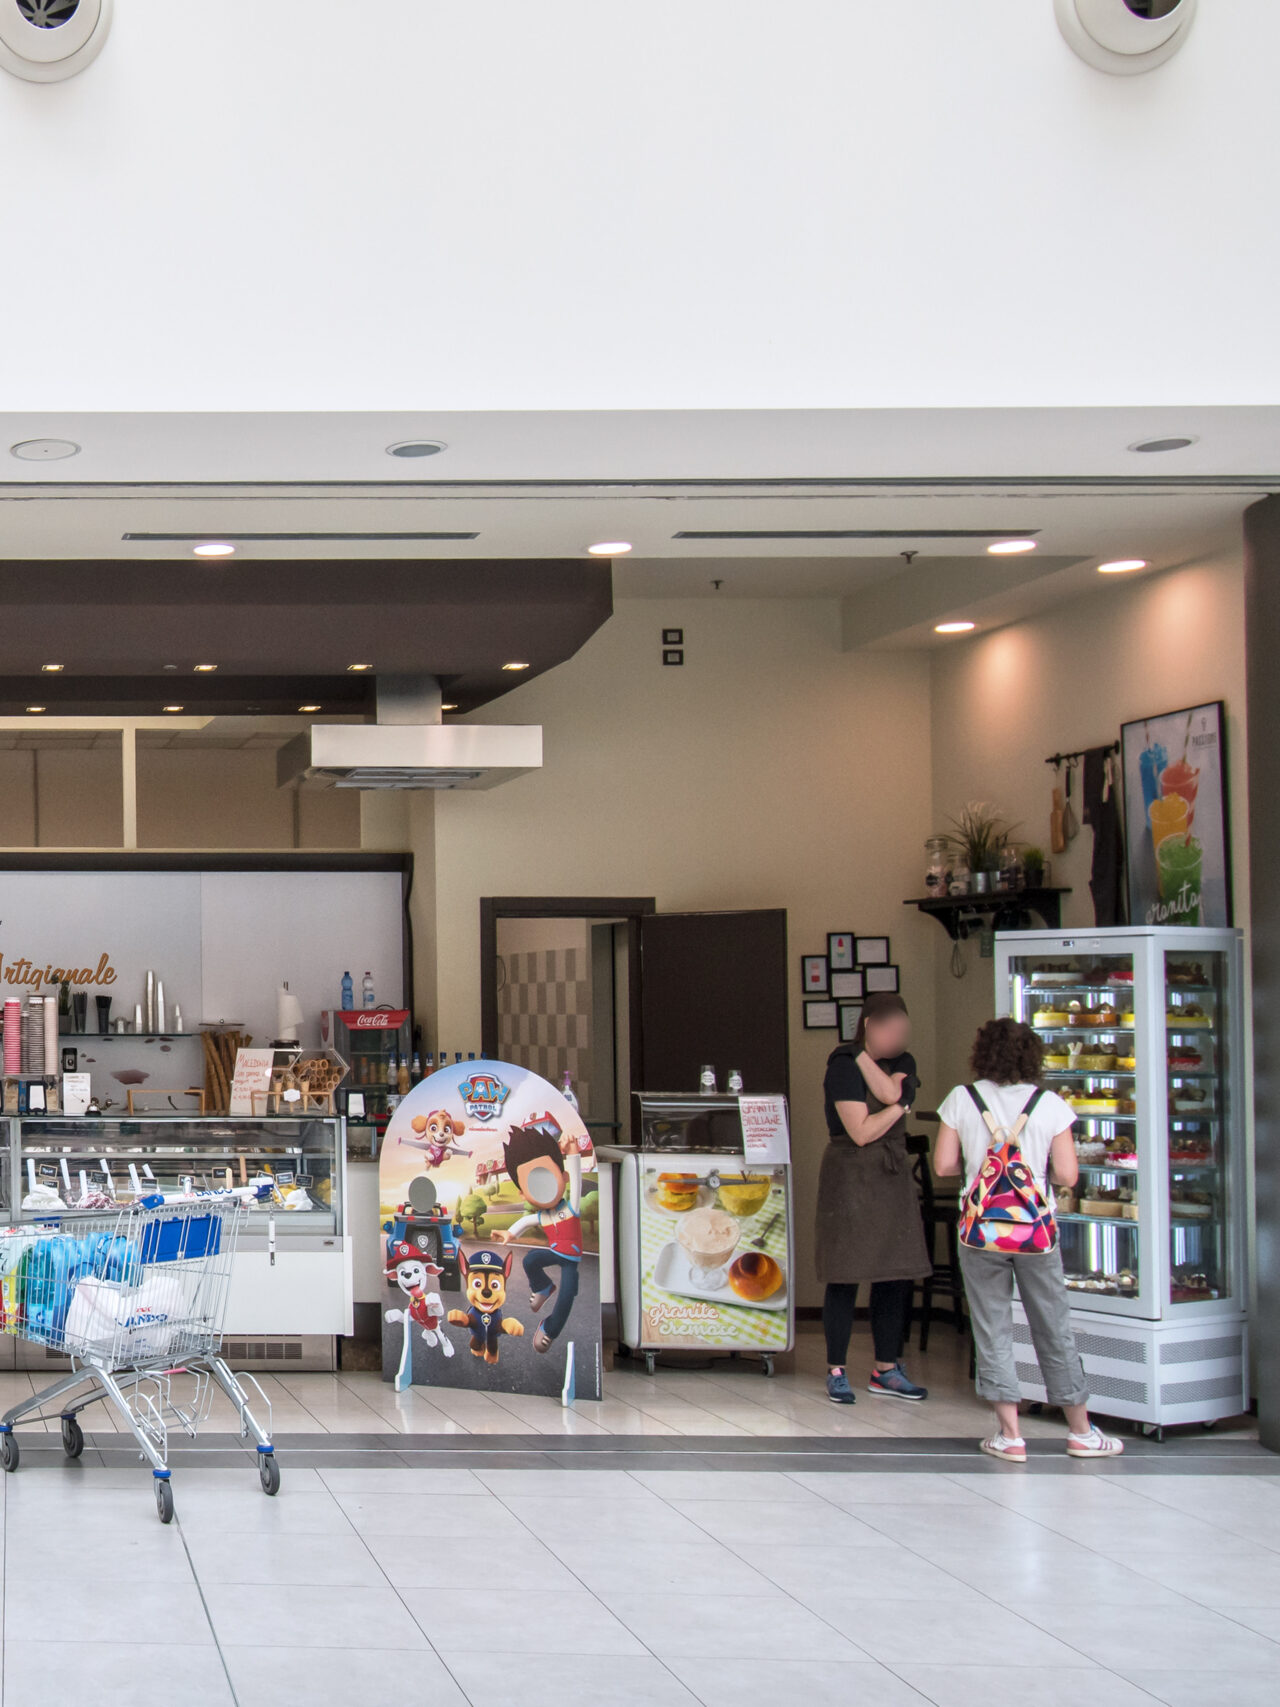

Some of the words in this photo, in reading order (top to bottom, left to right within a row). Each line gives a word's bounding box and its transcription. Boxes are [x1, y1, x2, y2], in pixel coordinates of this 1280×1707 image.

[457, 1080, 511, 1104] PAW
[742, 1104, 778, 1114] GRANITE
[649, 1302, 719, 1327] granite
